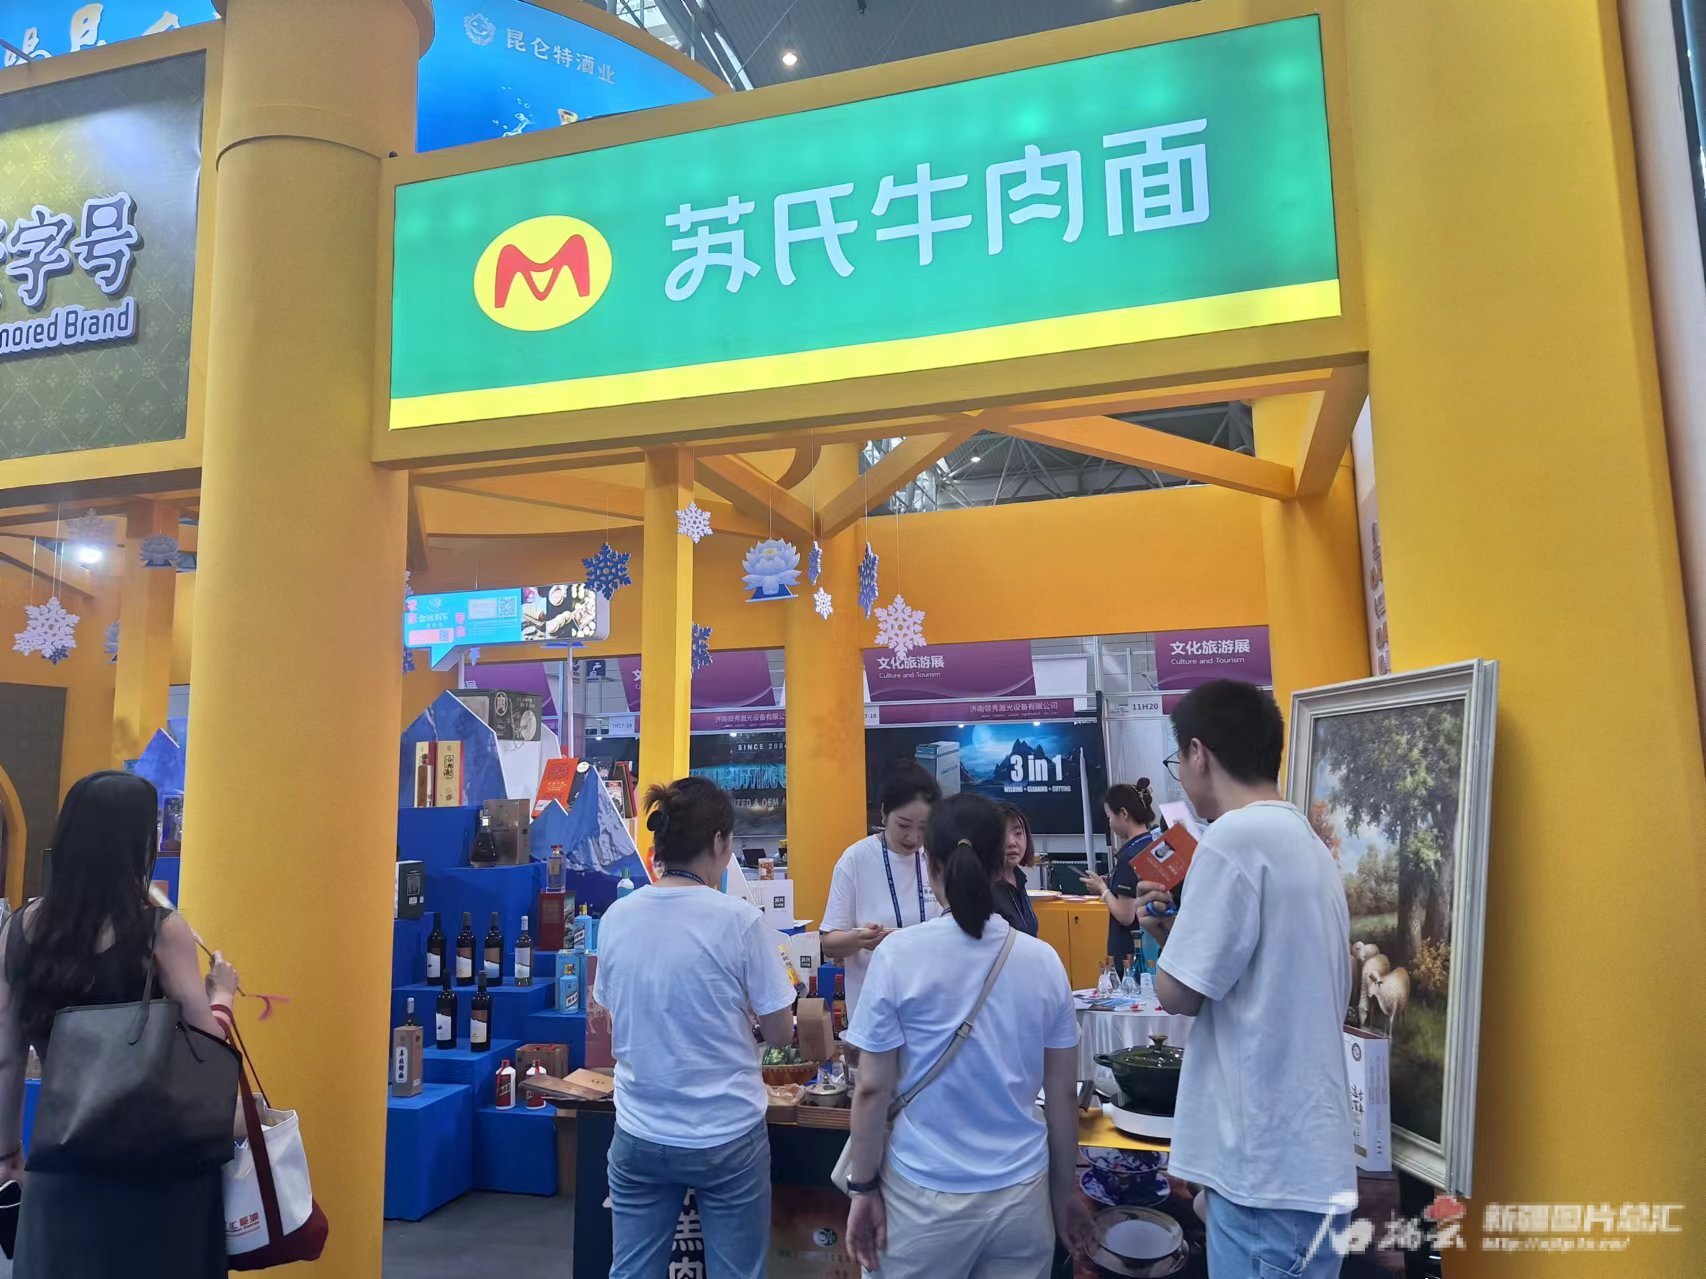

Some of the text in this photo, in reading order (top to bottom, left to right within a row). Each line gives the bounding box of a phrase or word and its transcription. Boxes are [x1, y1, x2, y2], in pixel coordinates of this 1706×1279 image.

[505, 28, 617, 85] 昆仑特酒业
[664, 118, 1210, 301] 苏氏牛肉面
[0, 192, 138, 306] 字号
[65, 302, 129, 339] Brand
[1169, 638, 1251, 656] 文化旅游展
[877, 655, 945, 669] 文化旅游展
[1215, 656, 1245, 664] Tourism
[1132, 703, 1159, 711] 11H20
[737, 743, 764, 751] SINCE
[1010, 754, 1063, 782] 3 in 1
